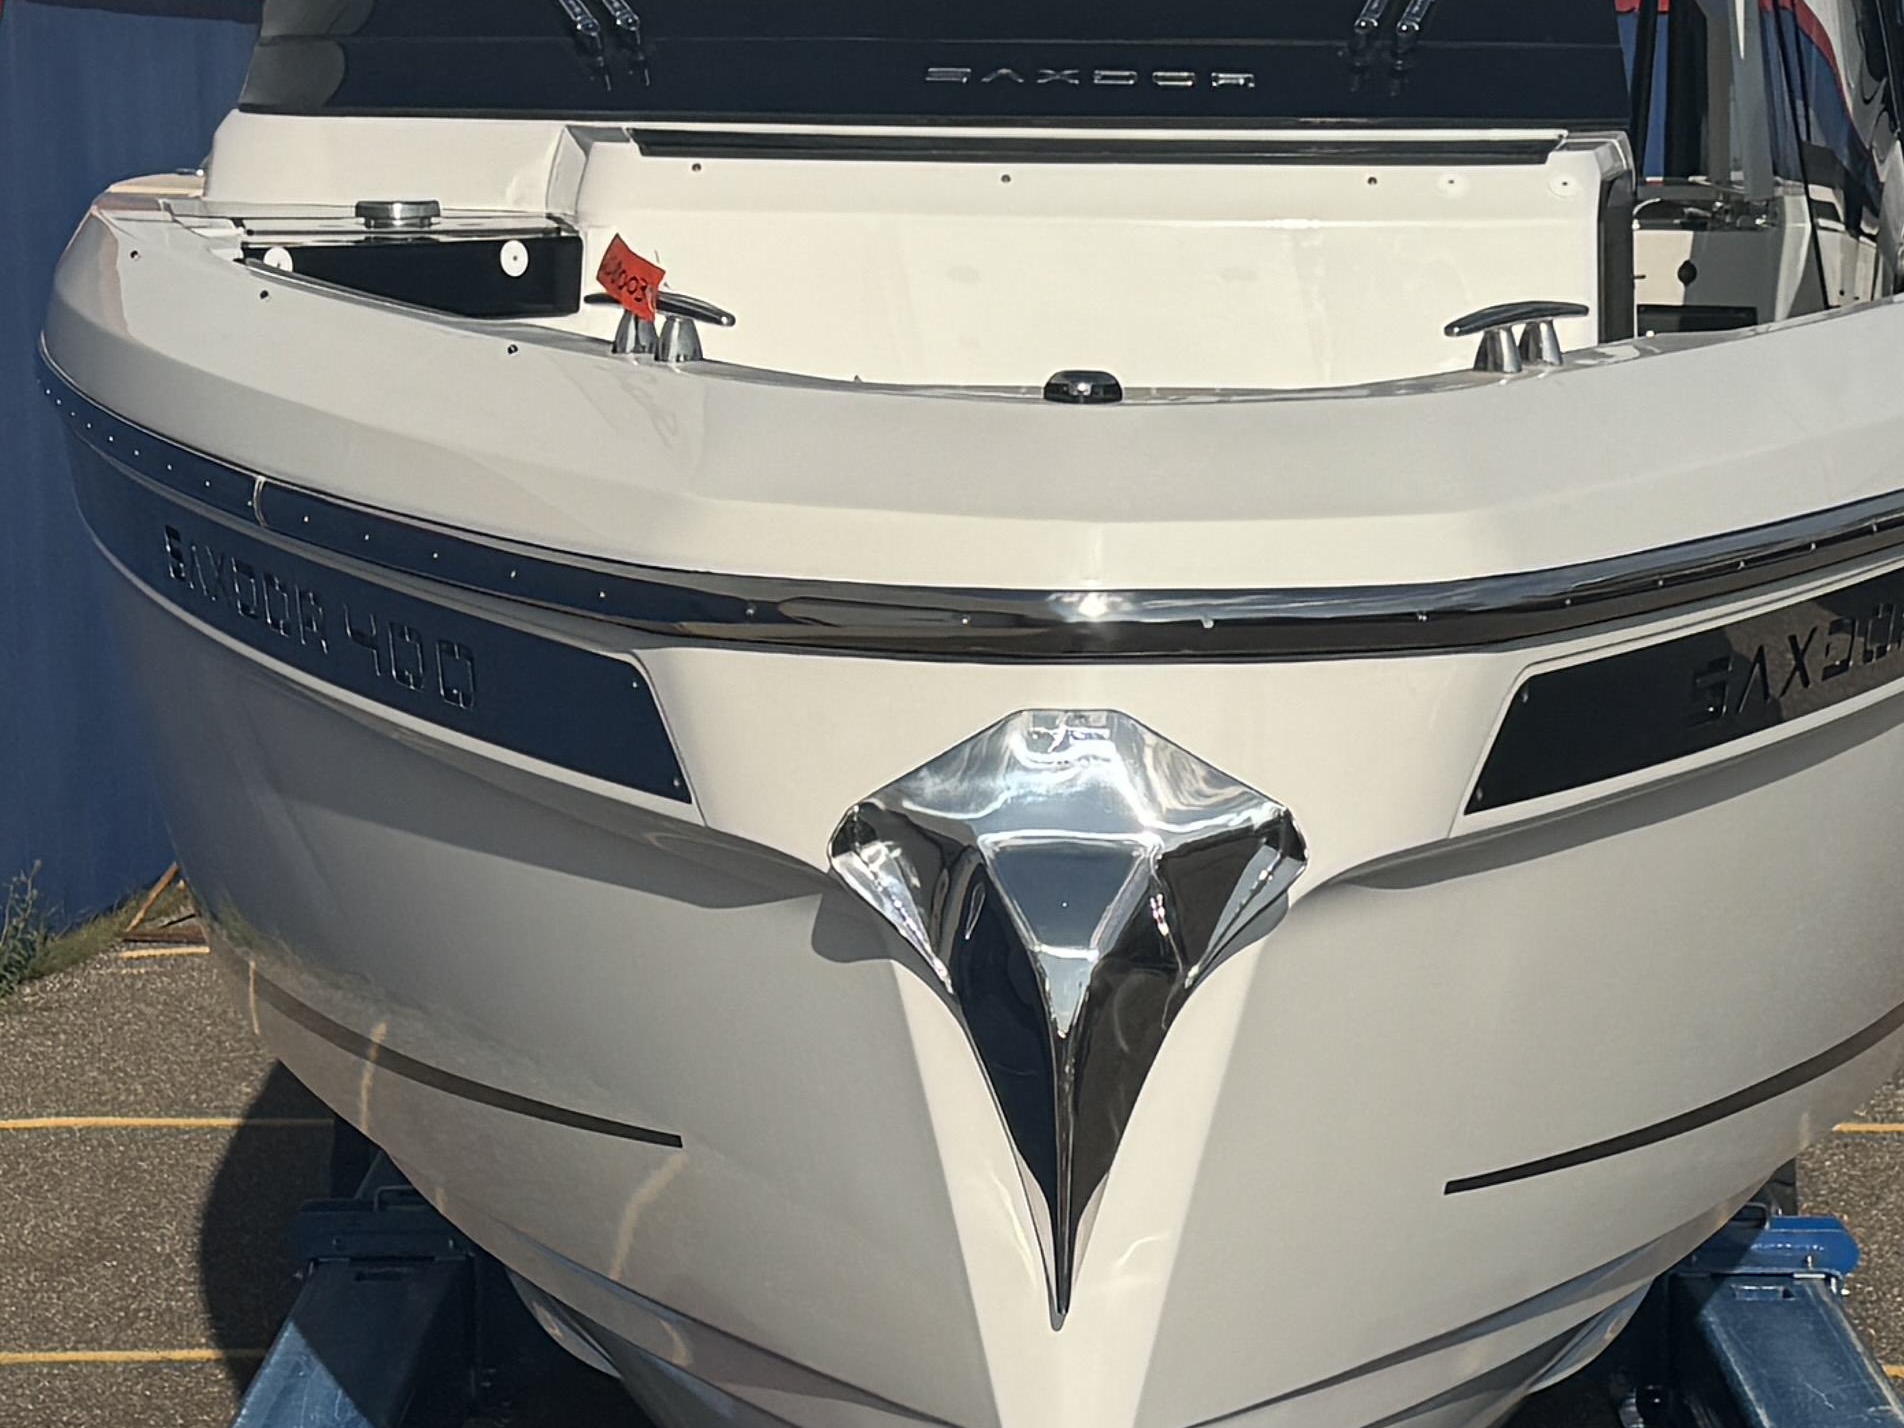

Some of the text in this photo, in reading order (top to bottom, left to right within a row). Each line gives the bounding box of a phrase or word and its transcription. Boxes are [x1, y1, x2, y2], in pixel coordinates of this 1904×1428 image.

[925, 67, 1256, 88] SAXDOR
[164, 524, 474, 710] SAXDOR 400
